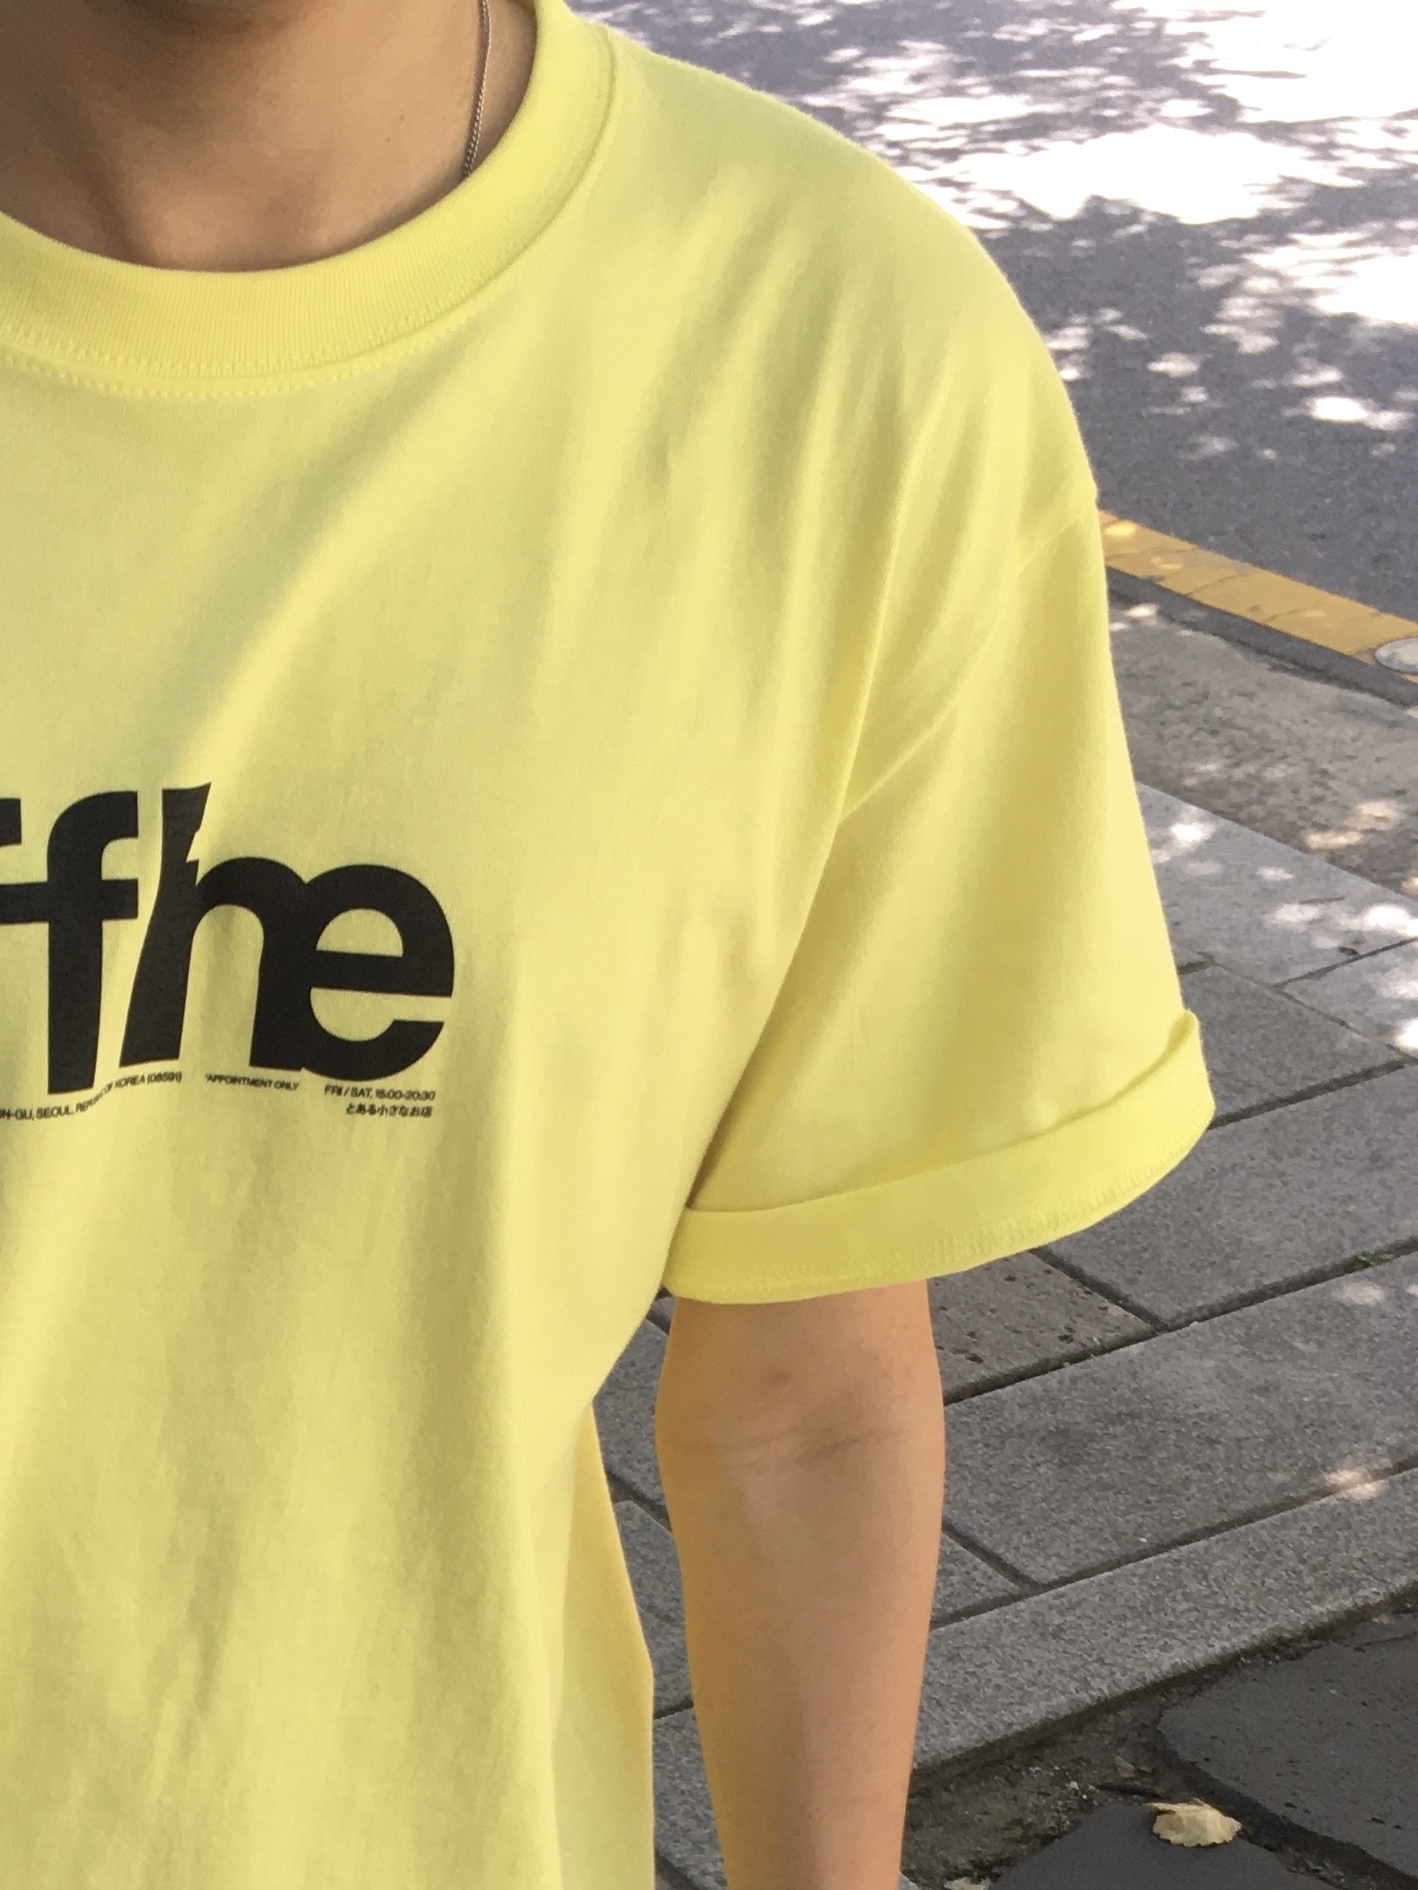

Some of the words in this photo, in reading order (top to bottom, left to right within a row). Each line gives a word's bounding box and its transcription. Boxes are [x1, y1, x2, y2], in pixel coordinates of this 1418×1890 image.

[114, 1074, 145, 1089] KOREA
[274, 1080, 300, 1092] ONLY
[324, 1084, 342, 1096] FRI
